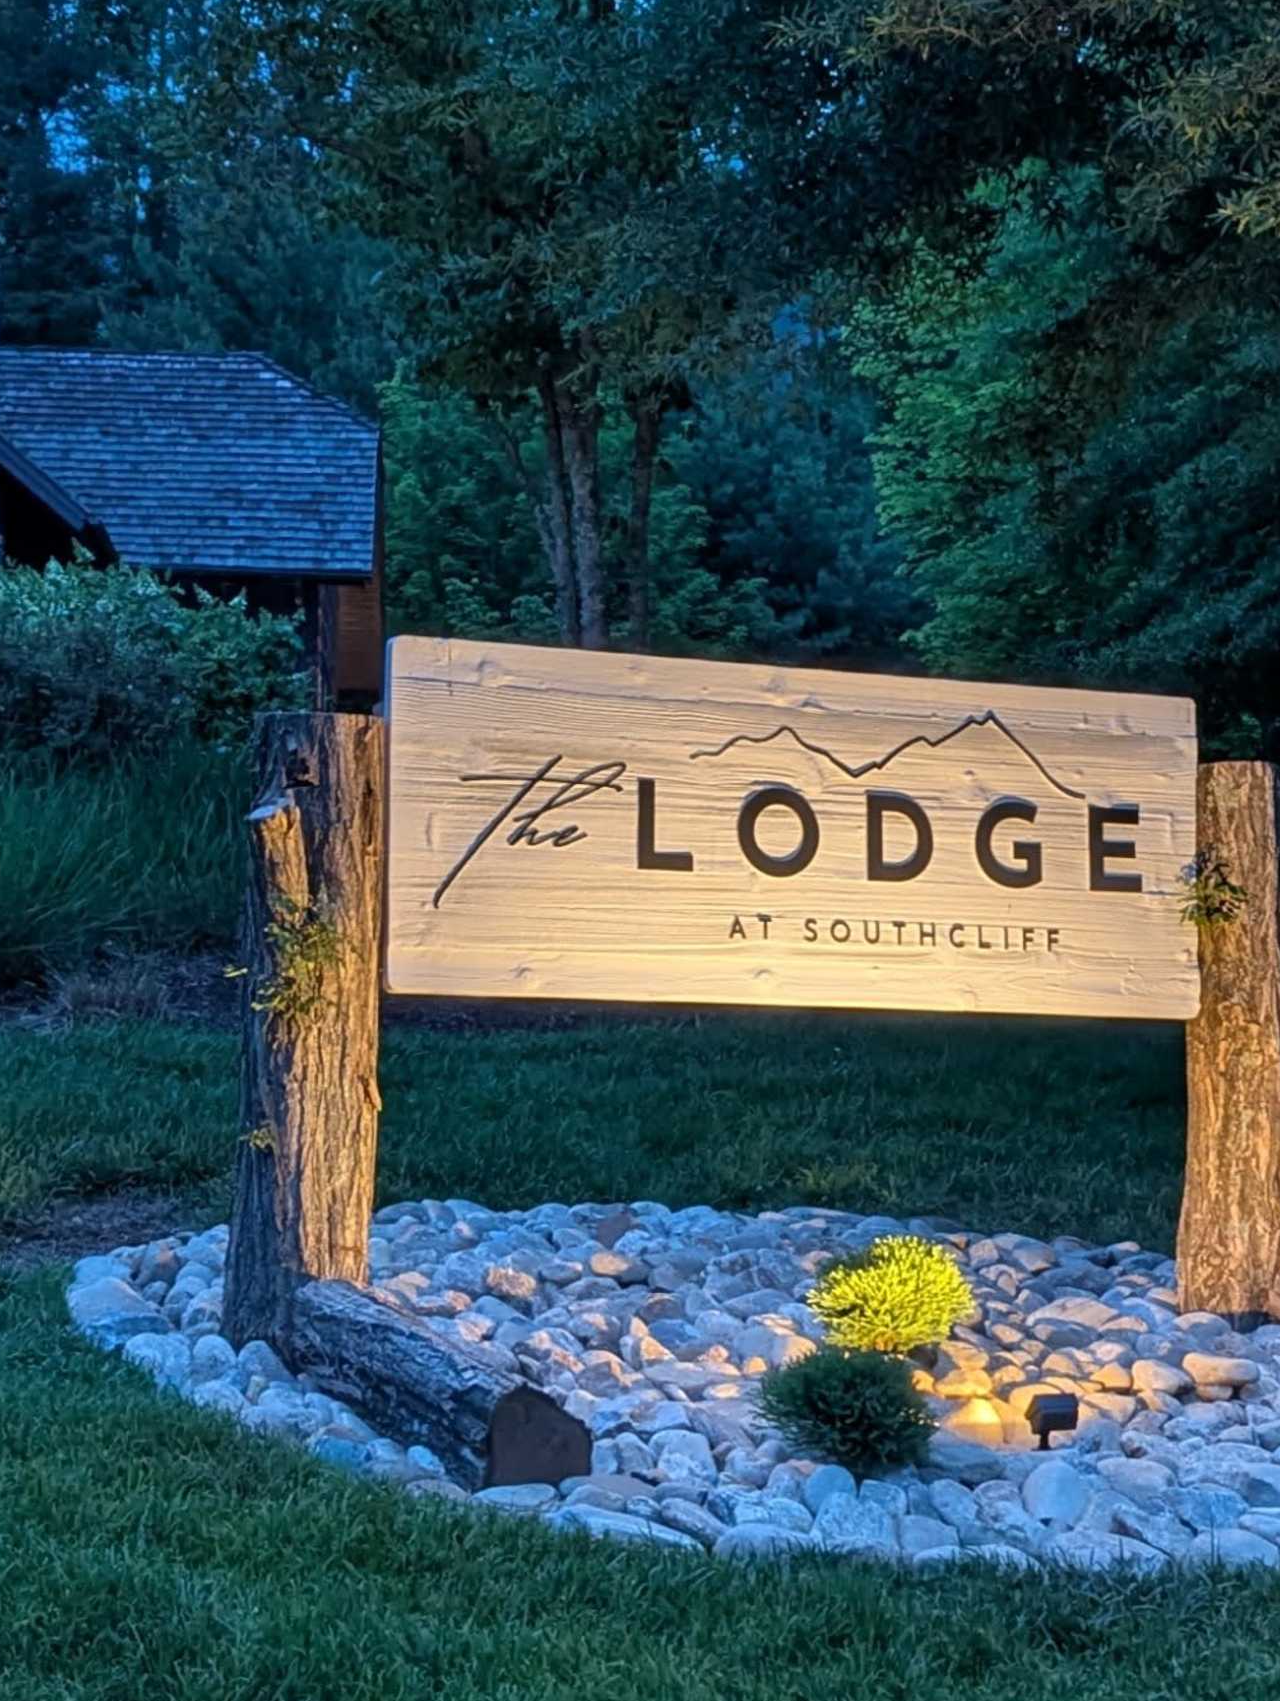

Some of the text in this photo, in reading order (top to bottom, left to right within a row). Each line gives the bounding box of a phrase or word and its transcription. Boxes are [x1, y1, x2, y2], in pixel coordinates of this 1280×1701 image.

[433, 755, 1143, 908] The LODGE
[729, 914, 1060, 952] AT SOUTHCLIFF
